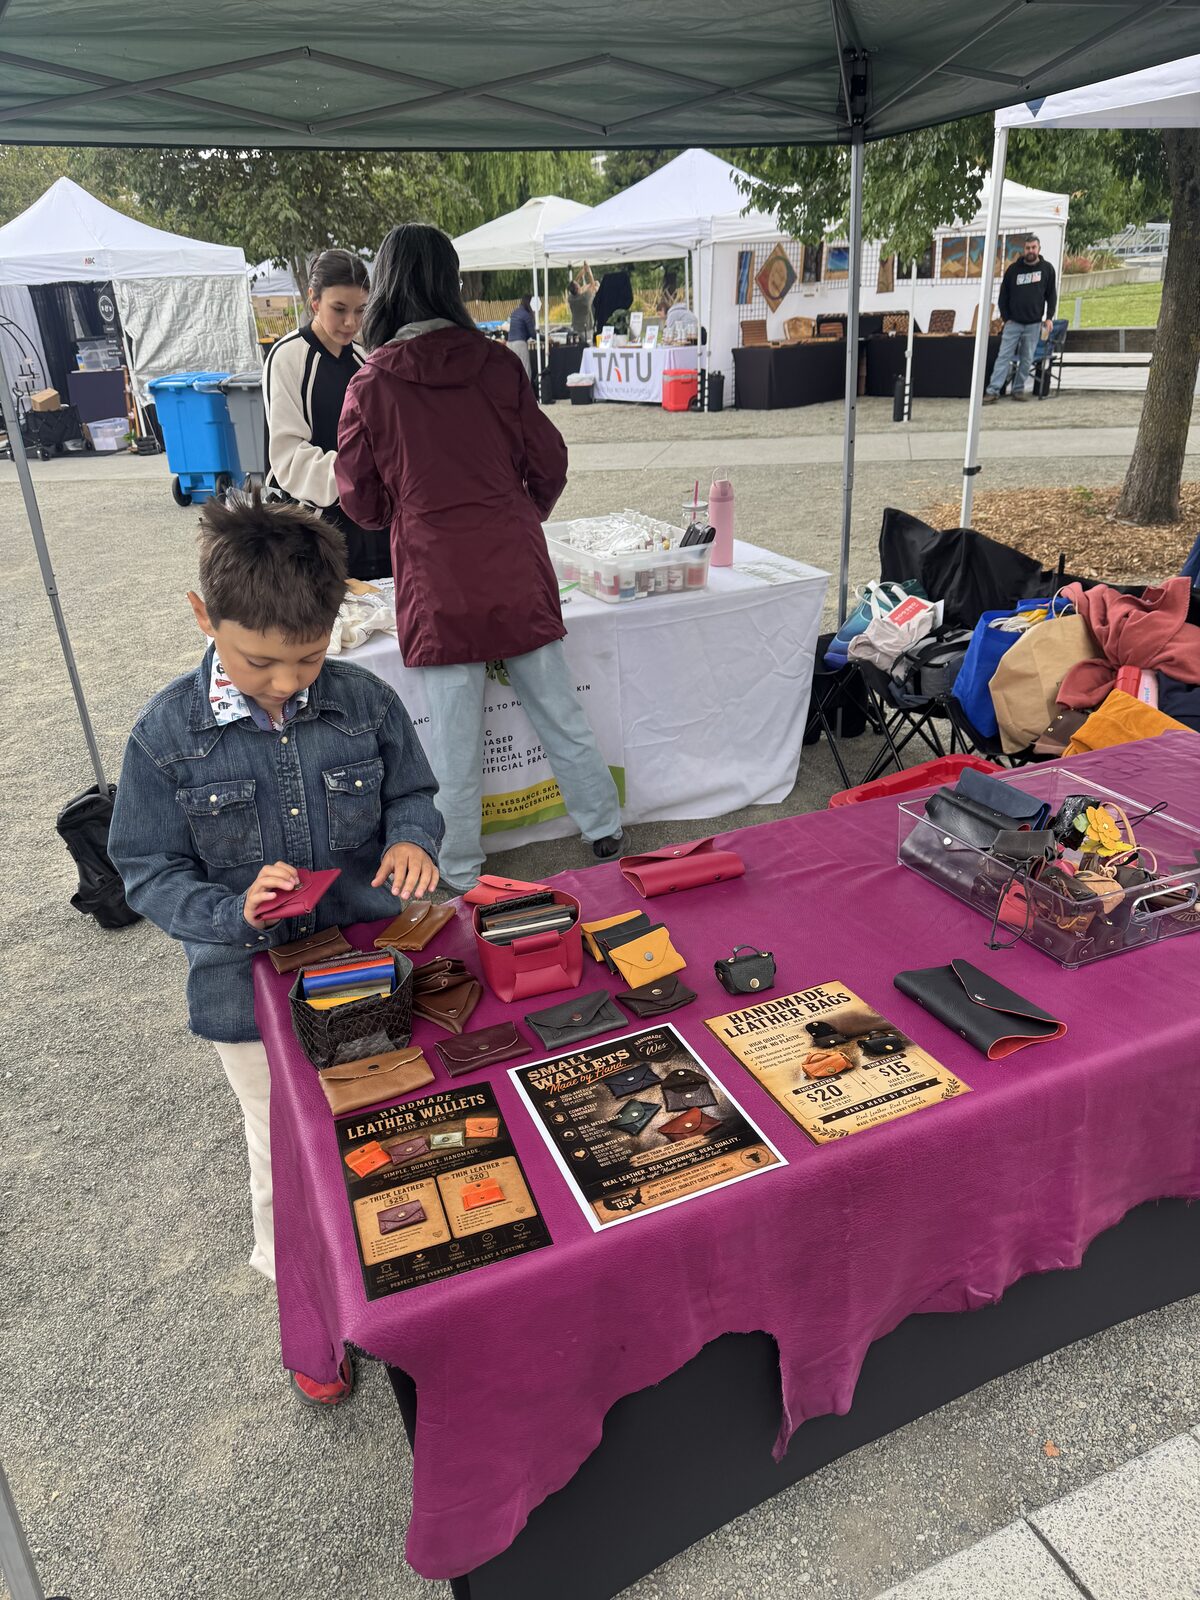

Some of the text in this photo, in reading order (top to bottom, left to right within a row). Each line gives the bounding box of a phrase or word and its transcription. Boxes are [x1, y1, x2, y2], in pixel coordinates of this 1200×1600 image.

[592, 352, 652, 384] TATU
[576, 684, 591, 692] KIN
[490, 744, 513, 754] FREE
[483, 753, 522, 765] IFICIAL
[727, 987, 830, 1024] HANDMADE
[723, 992, 852, 1038] LEATHER BAGS
[634, 1033, 663, 1046] HANDMADE
[640, 1041, 669, 1056] Wes
[526, 1053, 592, 1082] SMALL
[531, 1048, 630, 1091] WALLETS
[879, 1061, 912, 1077] $15
[545, 1074, 581, 1094] Made
[581, 1072, 592, 1084] by
[806, 1085, 844, 1103] $20
[843, 1104, 865, 1114] HAND
[866, 1096, 888, 1106] MADE
[900, 1086, 917, 1094] WES
[380, 1094, 452, 1118] HANDMADE
[568, 1102, 598, 1114] COMPLETELY
[347, 1094, 486, 1140] LEATHER WALLETS
[396, 1125, 417, 1133] MADE
[432, 1116, 447, 1124] WES
[590, 1118, 606, 1126] METAL
[451, 1169, 469, 1179] THIN
[470, 1161, 500, 1174] LEATHER
[602, 1177, 619, 1186] REAL
[618, 1168, 648, 1181] LEATHER.
[647, 1162, 664, 1171] REAL
[663, 1150, 699, 1165] HARDWARE.
[698, 1145, 714, 1154] REAL
[714, 1136, 741, 1148] QUALITY.
[470, 1172, 485, 1181] $20
[369, 1183, 425, 1204] THICK LEATHER
[646, 1192, 659, 1200] JUST
[677, 1179, 698, 1189] QUALITY
[388, 1196, 405, 1205] $25
[616, 1198, 635, 1208] USA
[481, 1253, 494, 1261] LAST
